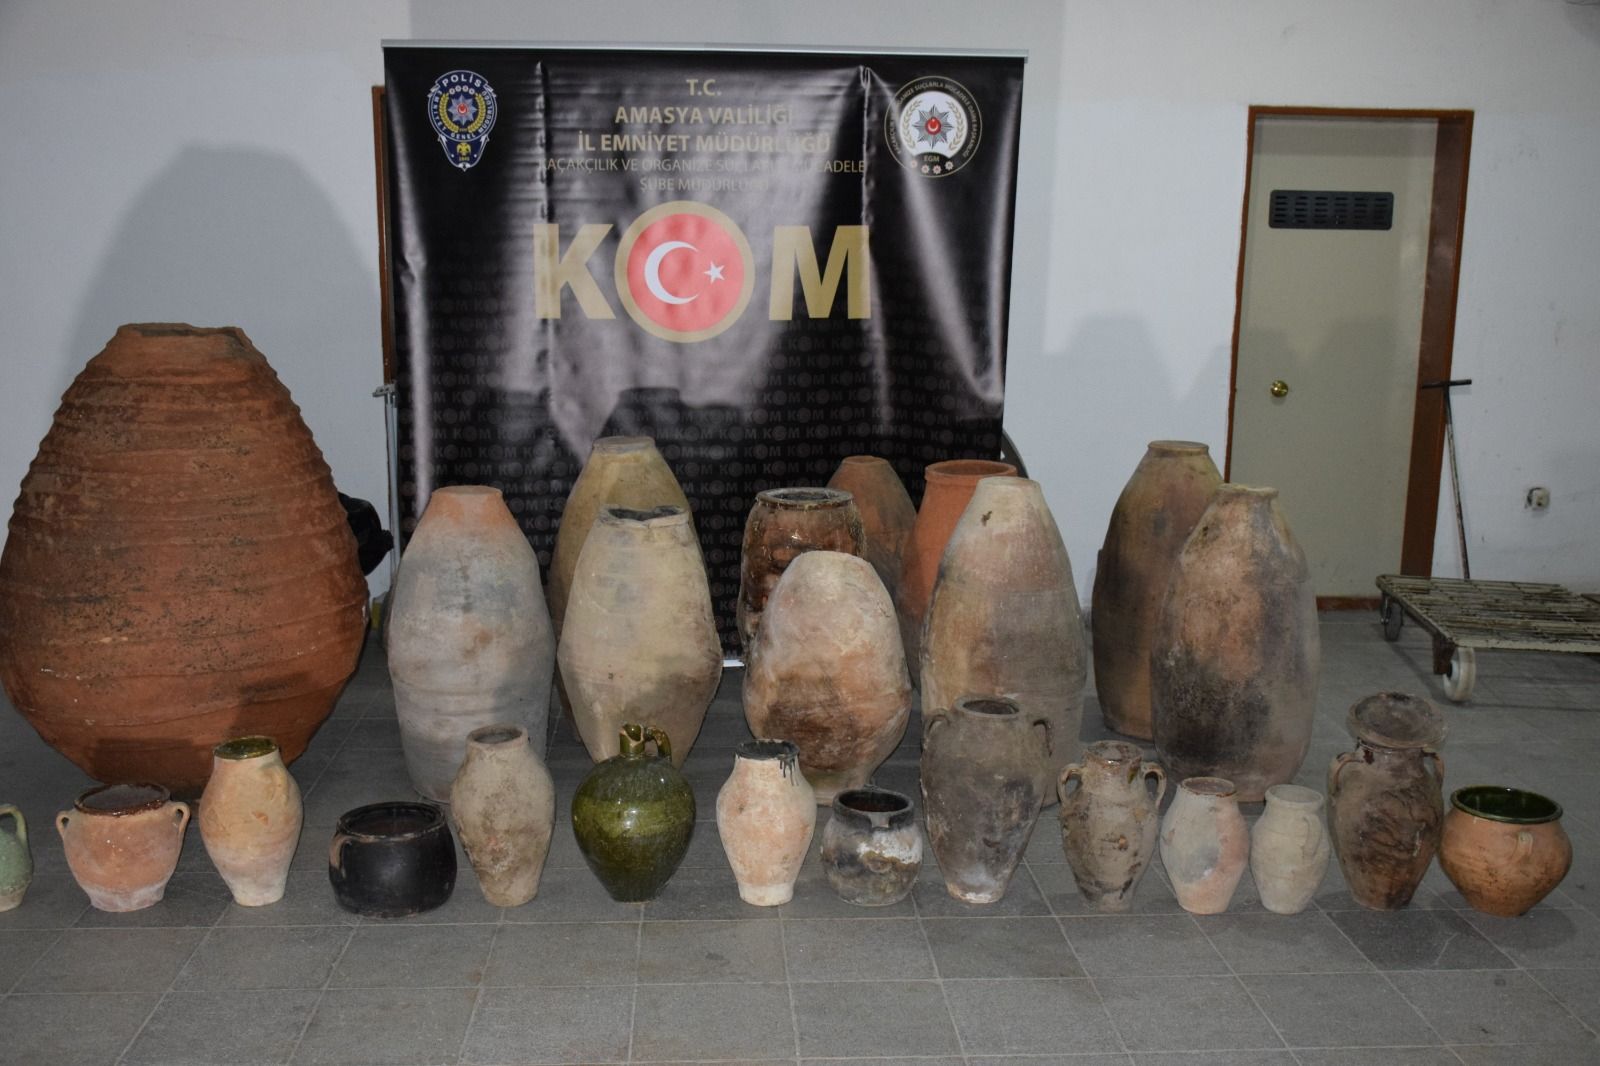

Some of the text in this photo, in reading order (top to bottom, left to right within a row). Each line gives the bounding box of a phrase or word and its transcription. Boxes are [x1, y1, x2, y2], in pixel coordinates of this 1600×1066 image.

[686, 79, 722, 96] T.C.
[615, 106, 703, 124] AMASYA
[578, 130, 831, 152] İL EMNİYET MÜDÜRLÜĞÜ
[621, 158, 639, 171] VE
[924, 155, 940, 163] EGM
